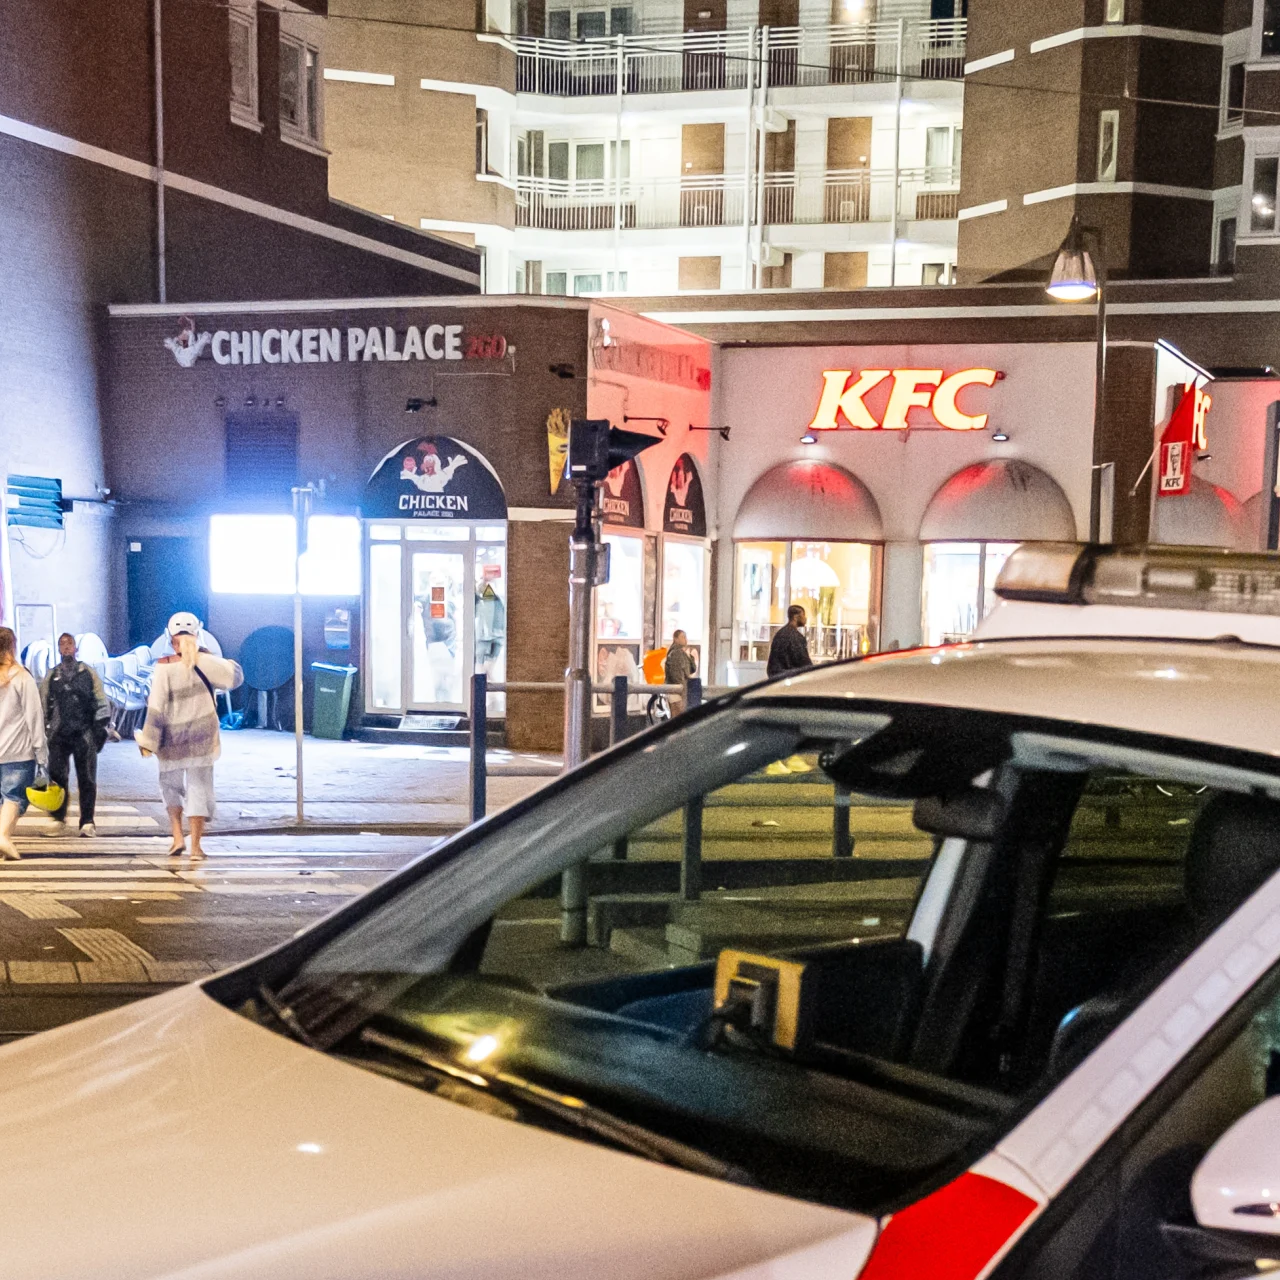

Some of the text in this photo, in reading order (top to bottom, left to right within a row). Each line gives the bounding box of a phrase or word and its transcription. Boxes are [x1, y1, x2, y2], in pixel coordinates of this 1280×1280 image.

[211, 328, 342, 366] CHICKEN
[347, 325, 464, 361] PALACE
[808, 368, 997, 431] KFC
[1164, 477, 1181, 488] KFC
[398, 495, 469, 512] CHICKEN
[413, 510, 440, 518] PALACE
